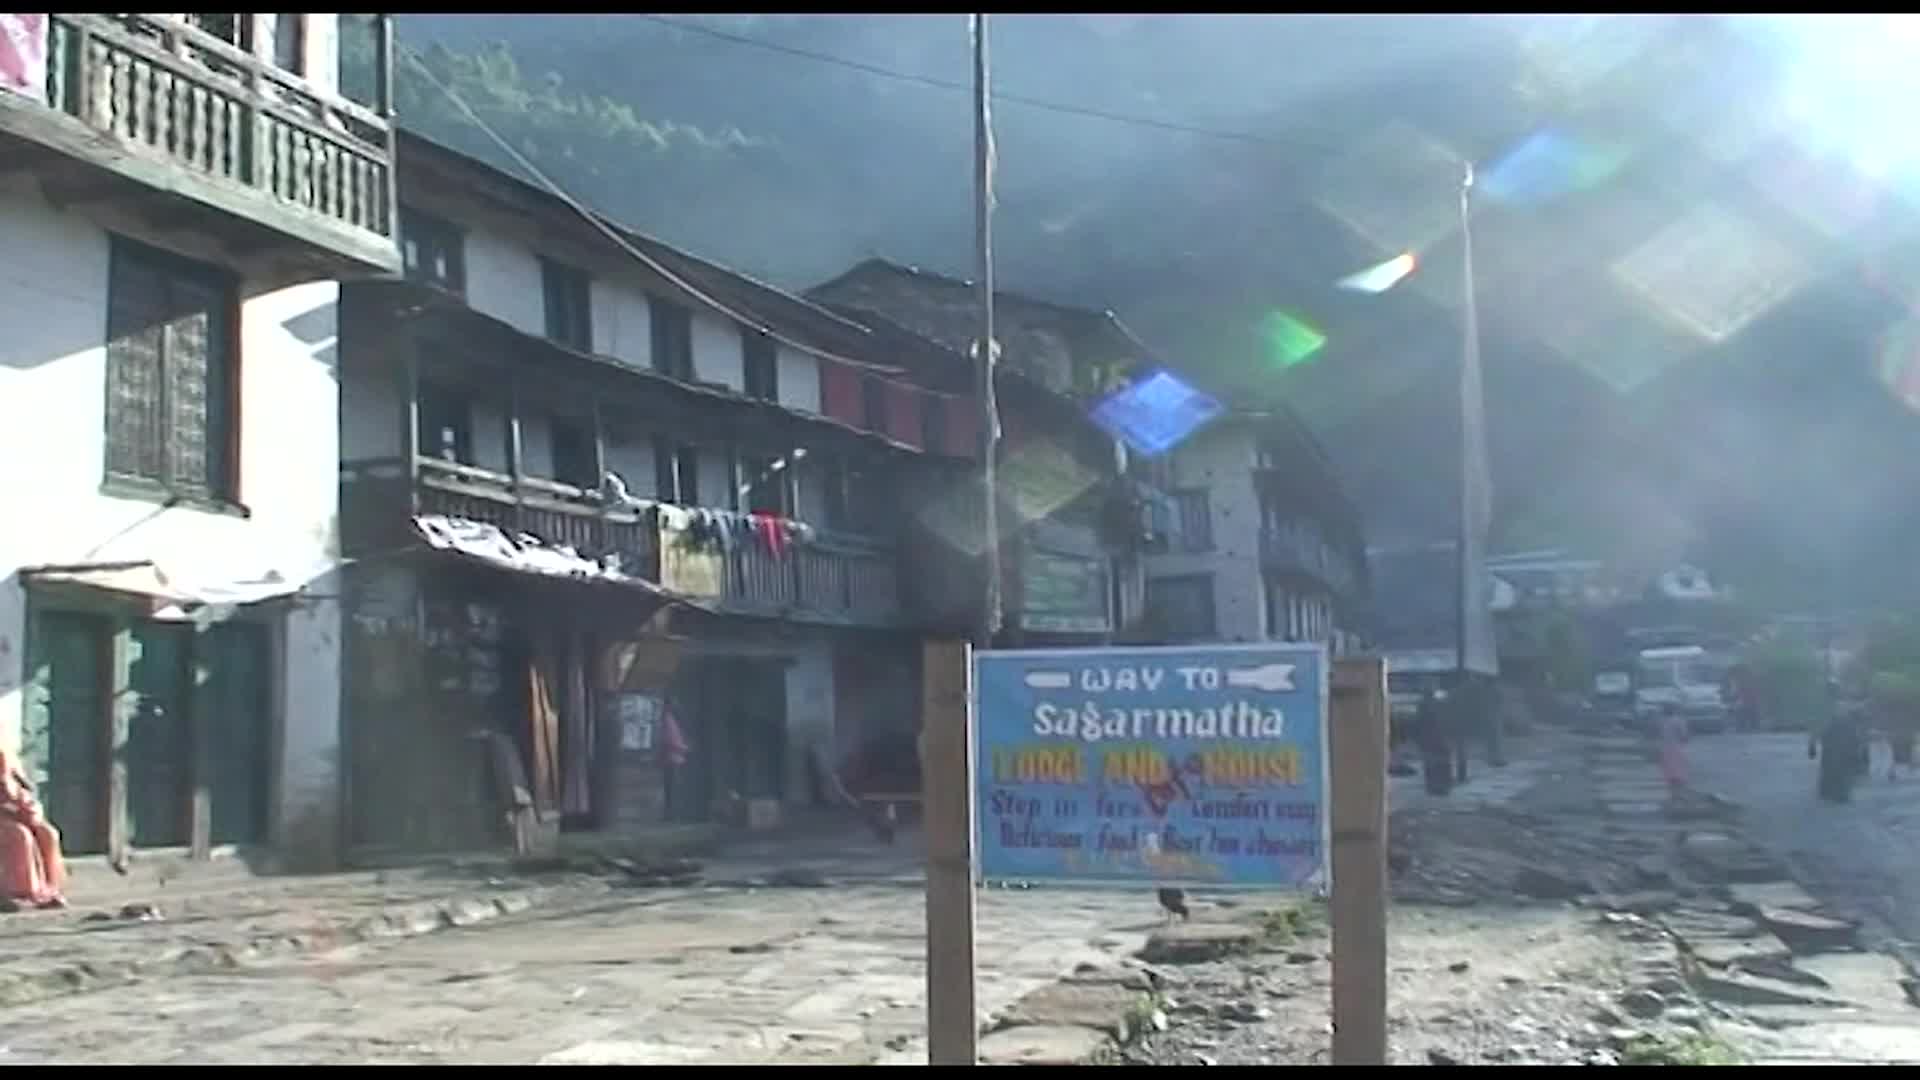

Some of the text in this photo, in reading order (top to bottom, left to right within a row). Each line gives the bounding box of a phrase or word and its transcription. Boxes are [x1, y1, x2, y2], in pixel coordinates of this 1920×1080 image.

[1081, 667, 1218, 691] WAY TO
[1033, 701, 1283, 741] Sagarmatha
[992, 748, 1082, 783] LODGE
[990, 790, 1041, 822] Step
